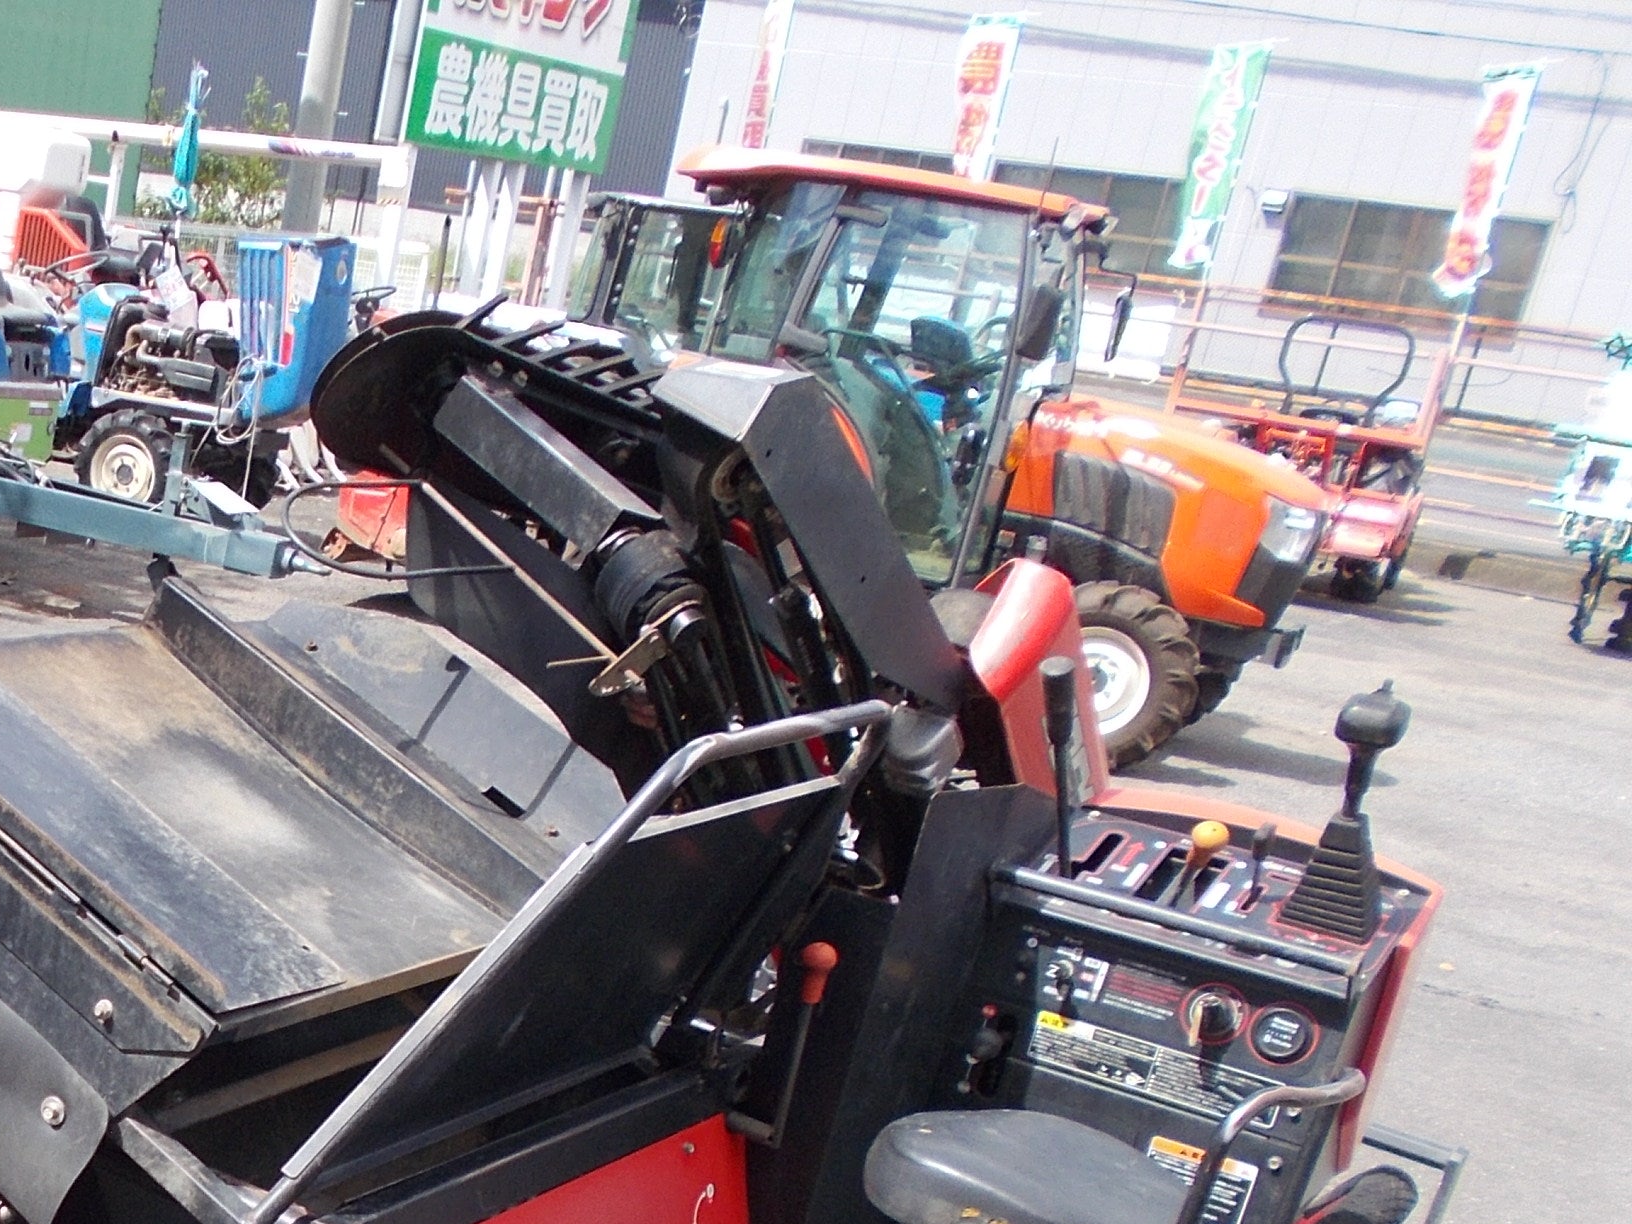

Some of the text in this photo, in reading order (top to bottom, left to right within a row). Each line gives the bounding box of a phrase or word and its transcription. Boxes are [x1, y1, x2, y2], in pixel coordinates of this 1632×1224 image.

[425, 41, 610, 162] 農機具買取
